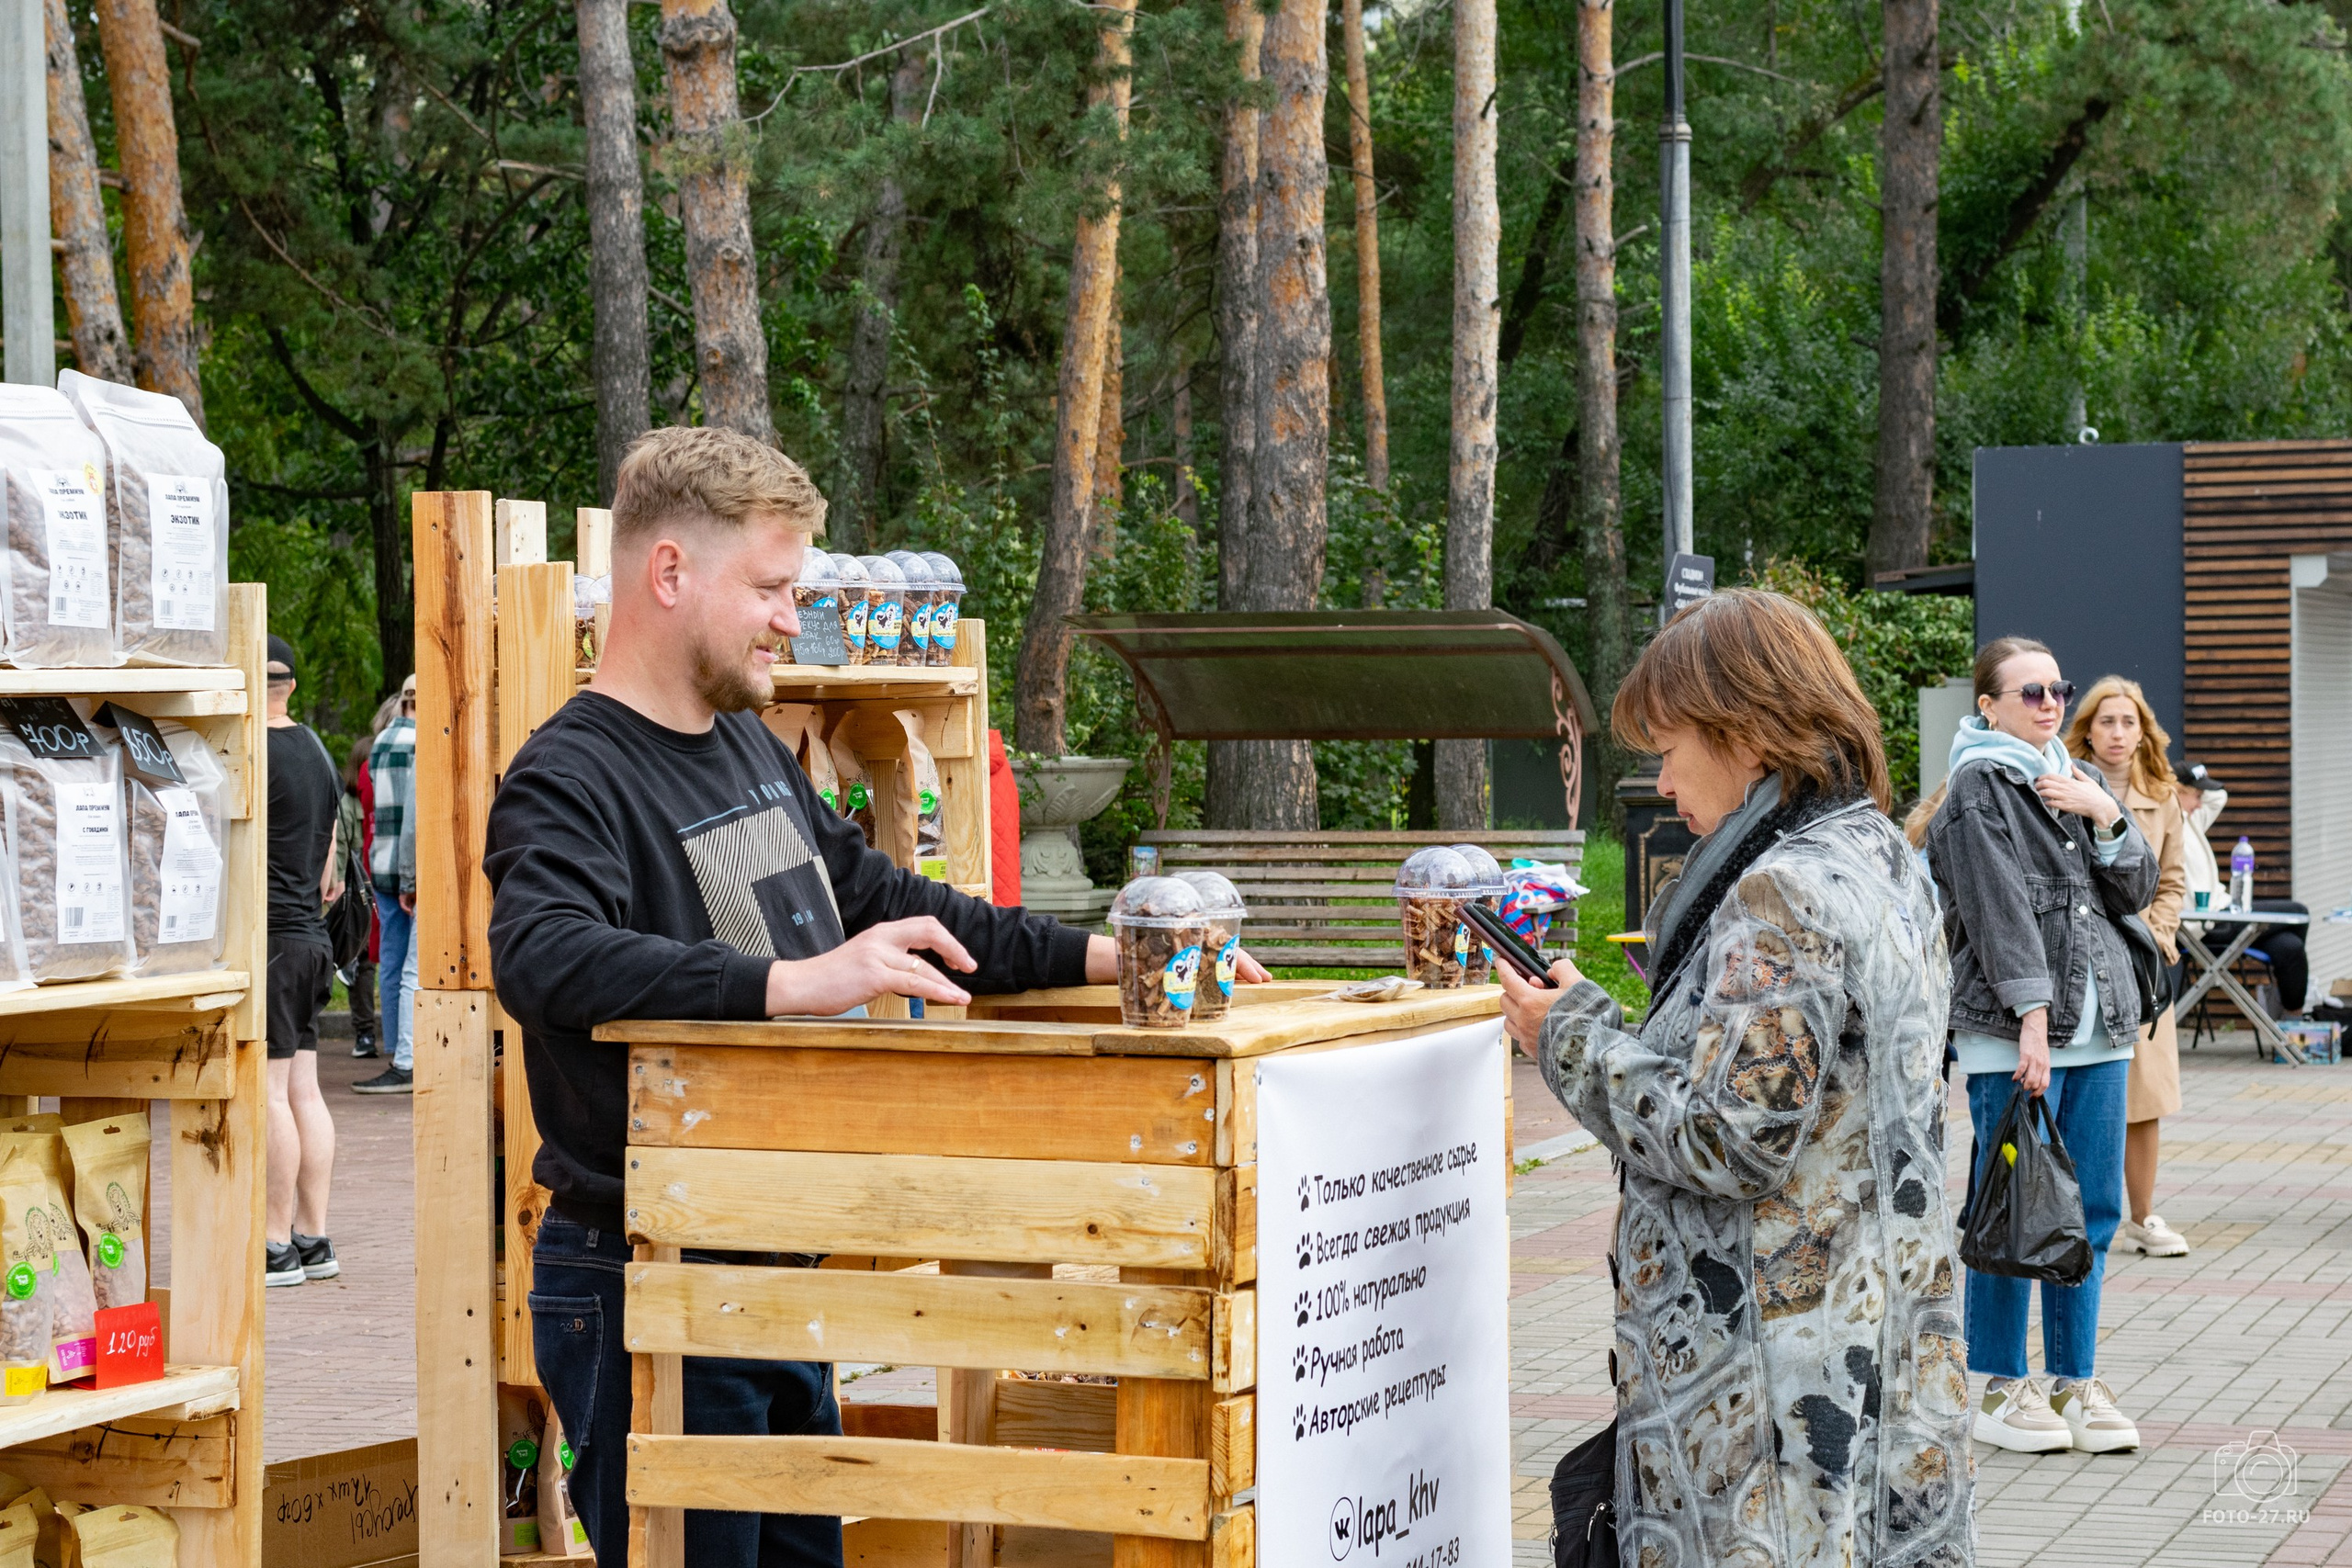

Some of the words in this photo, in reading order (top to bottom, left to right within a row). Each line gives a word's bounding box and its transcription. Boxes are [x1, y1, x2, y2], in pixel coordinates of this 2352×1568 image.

[58, 510, 88, 521] КЗОТИК
[170, 513, 200, 525] ЭКЗОТИК
[122, 726, 178, 777] 850р
[1314, 1173, 1365, 1206] Только
[1372, 1151, 1443, 1193] качественное
[1447, 1142, 1477, 1176] сырье
[1317, 1231, 1358, 1265] Всегда
[1364, 1217, 1410, 1250] свежая
[1416, 1198, 1471, 1244] продукция
[1316, 1280, 1349, 1321] 100%
[1353, 1266, 1426, 1312] натурально
[1310, 1343, 1357, 1387] Ручная
[1363, 1325, 1404, 1372] работа
[1309, 1392, 1380, 1437] Авторские
[1385, 1364, 1446, 1419] рецептуры
[351, 1479, 418, 1544] рекусы
[1358, 1468, 1440, 1557] lapa_khv
